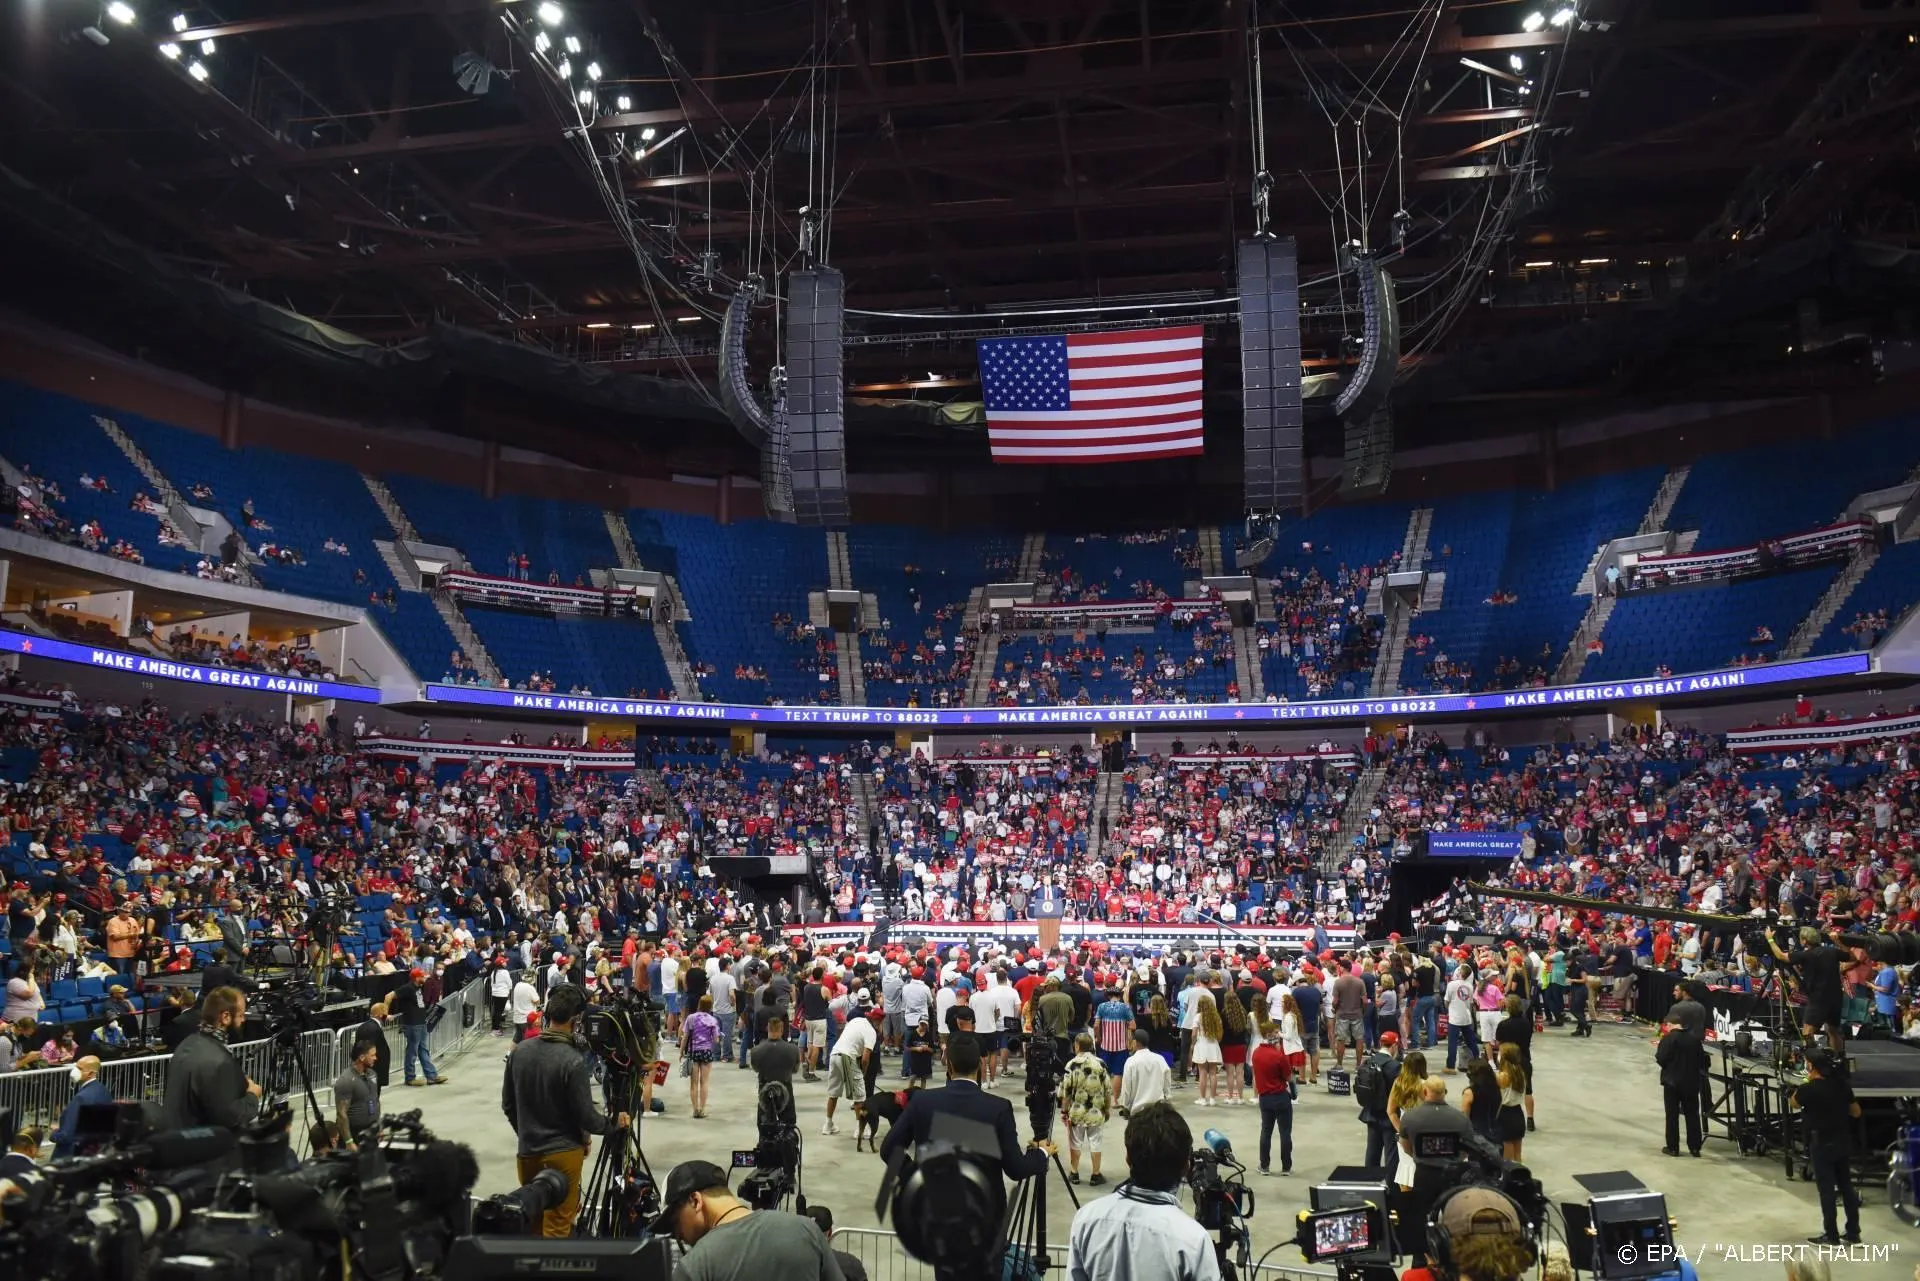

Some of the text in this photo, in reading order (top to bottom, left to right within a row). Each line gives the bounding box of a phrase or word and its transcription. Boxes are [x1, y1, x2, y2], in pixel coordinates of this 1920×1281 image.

[92, 651, 319, 694] MAKE AMERICA GREAT AGAIN!
[1504, 673, 1745, 706] MAKE AMERICA GREAT AGAIN!
[513, 695, 725, 718] MAKE AMERICA GREAT AGAIN!
[999, 709, 1208, 722] MAKE AMERICA GREAT AGAIN!
[1271, 701, 1436, 718] TEXT TRUMP TO 88022
[785, 711, 938, 723] TEXT TRUMP TO 88022
